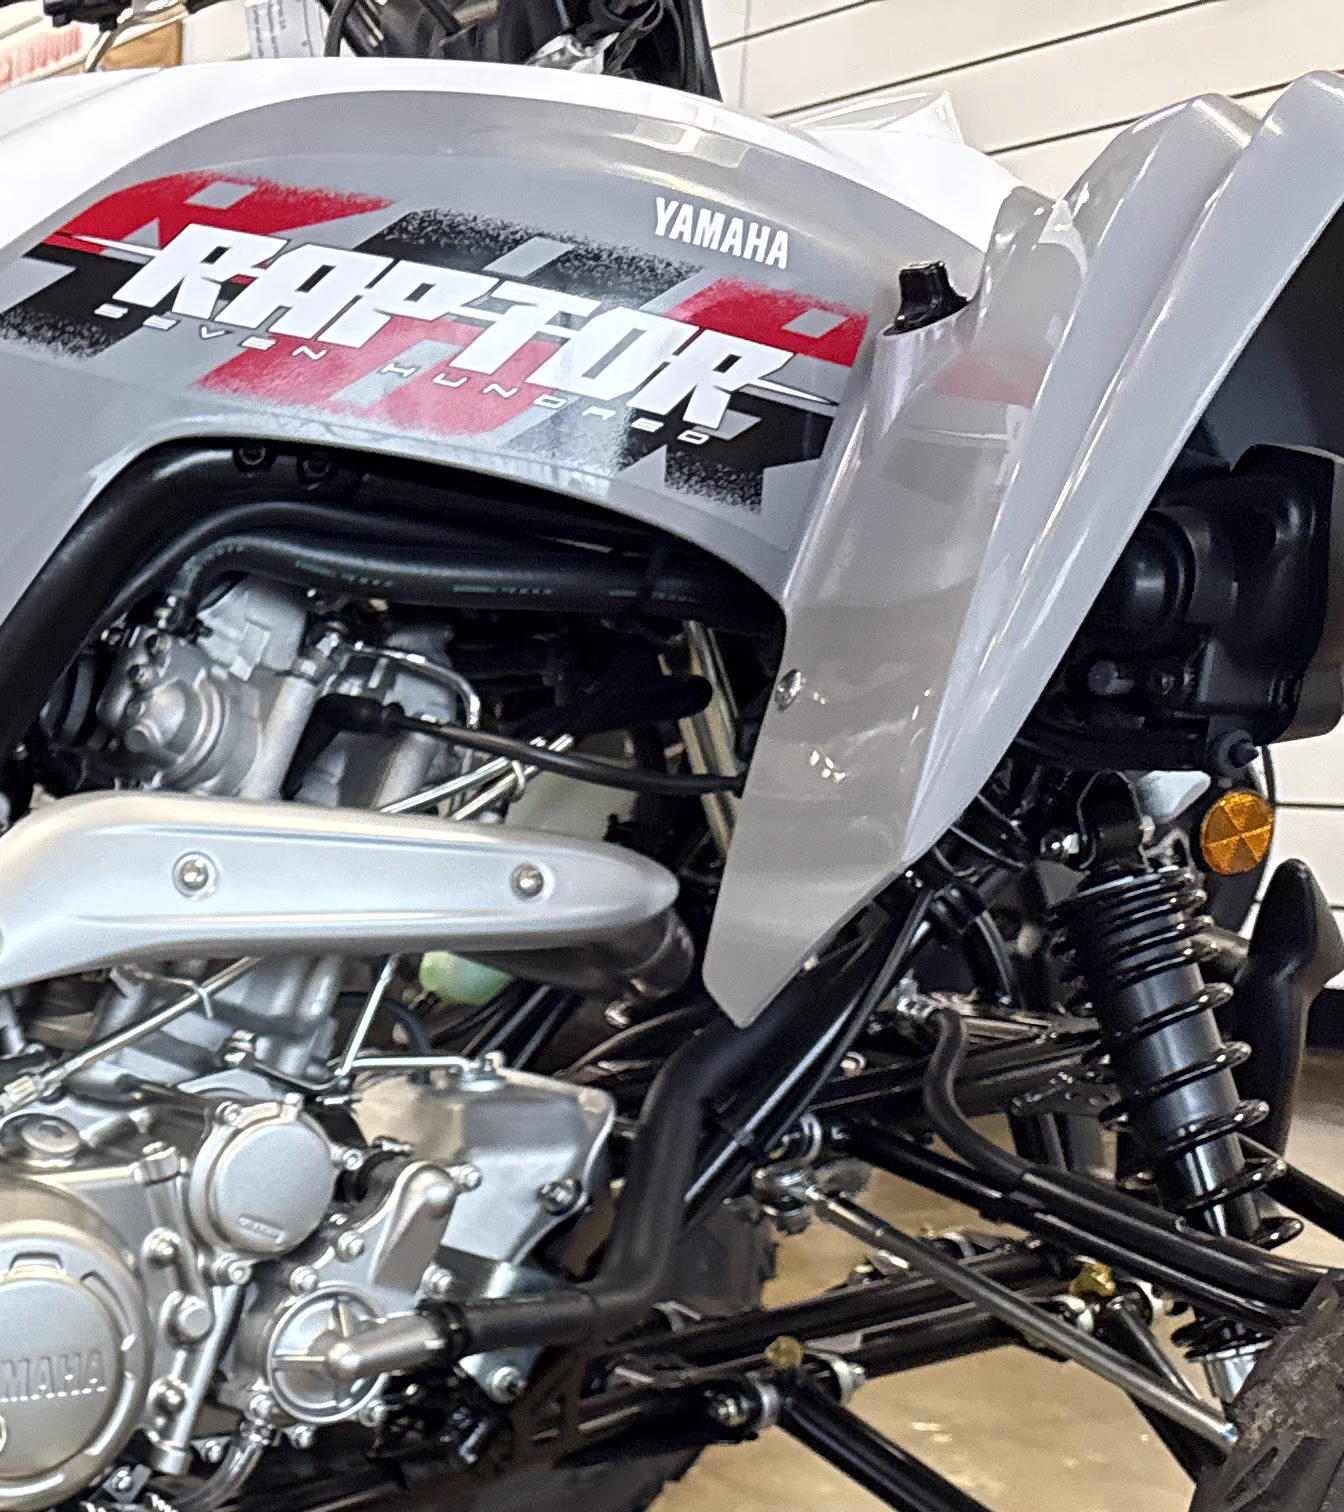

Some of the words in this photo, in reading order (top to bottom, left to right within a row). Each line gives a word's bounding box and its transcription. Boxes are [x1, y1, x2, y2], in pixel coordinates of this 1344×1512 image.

[653, 195, 790, 270] YAMAHA
[94, 306, 329, 362] SEVEN
[379, 363, 712, 447] HUNDRED
[112, 222, 796, 431] RAPTOR
